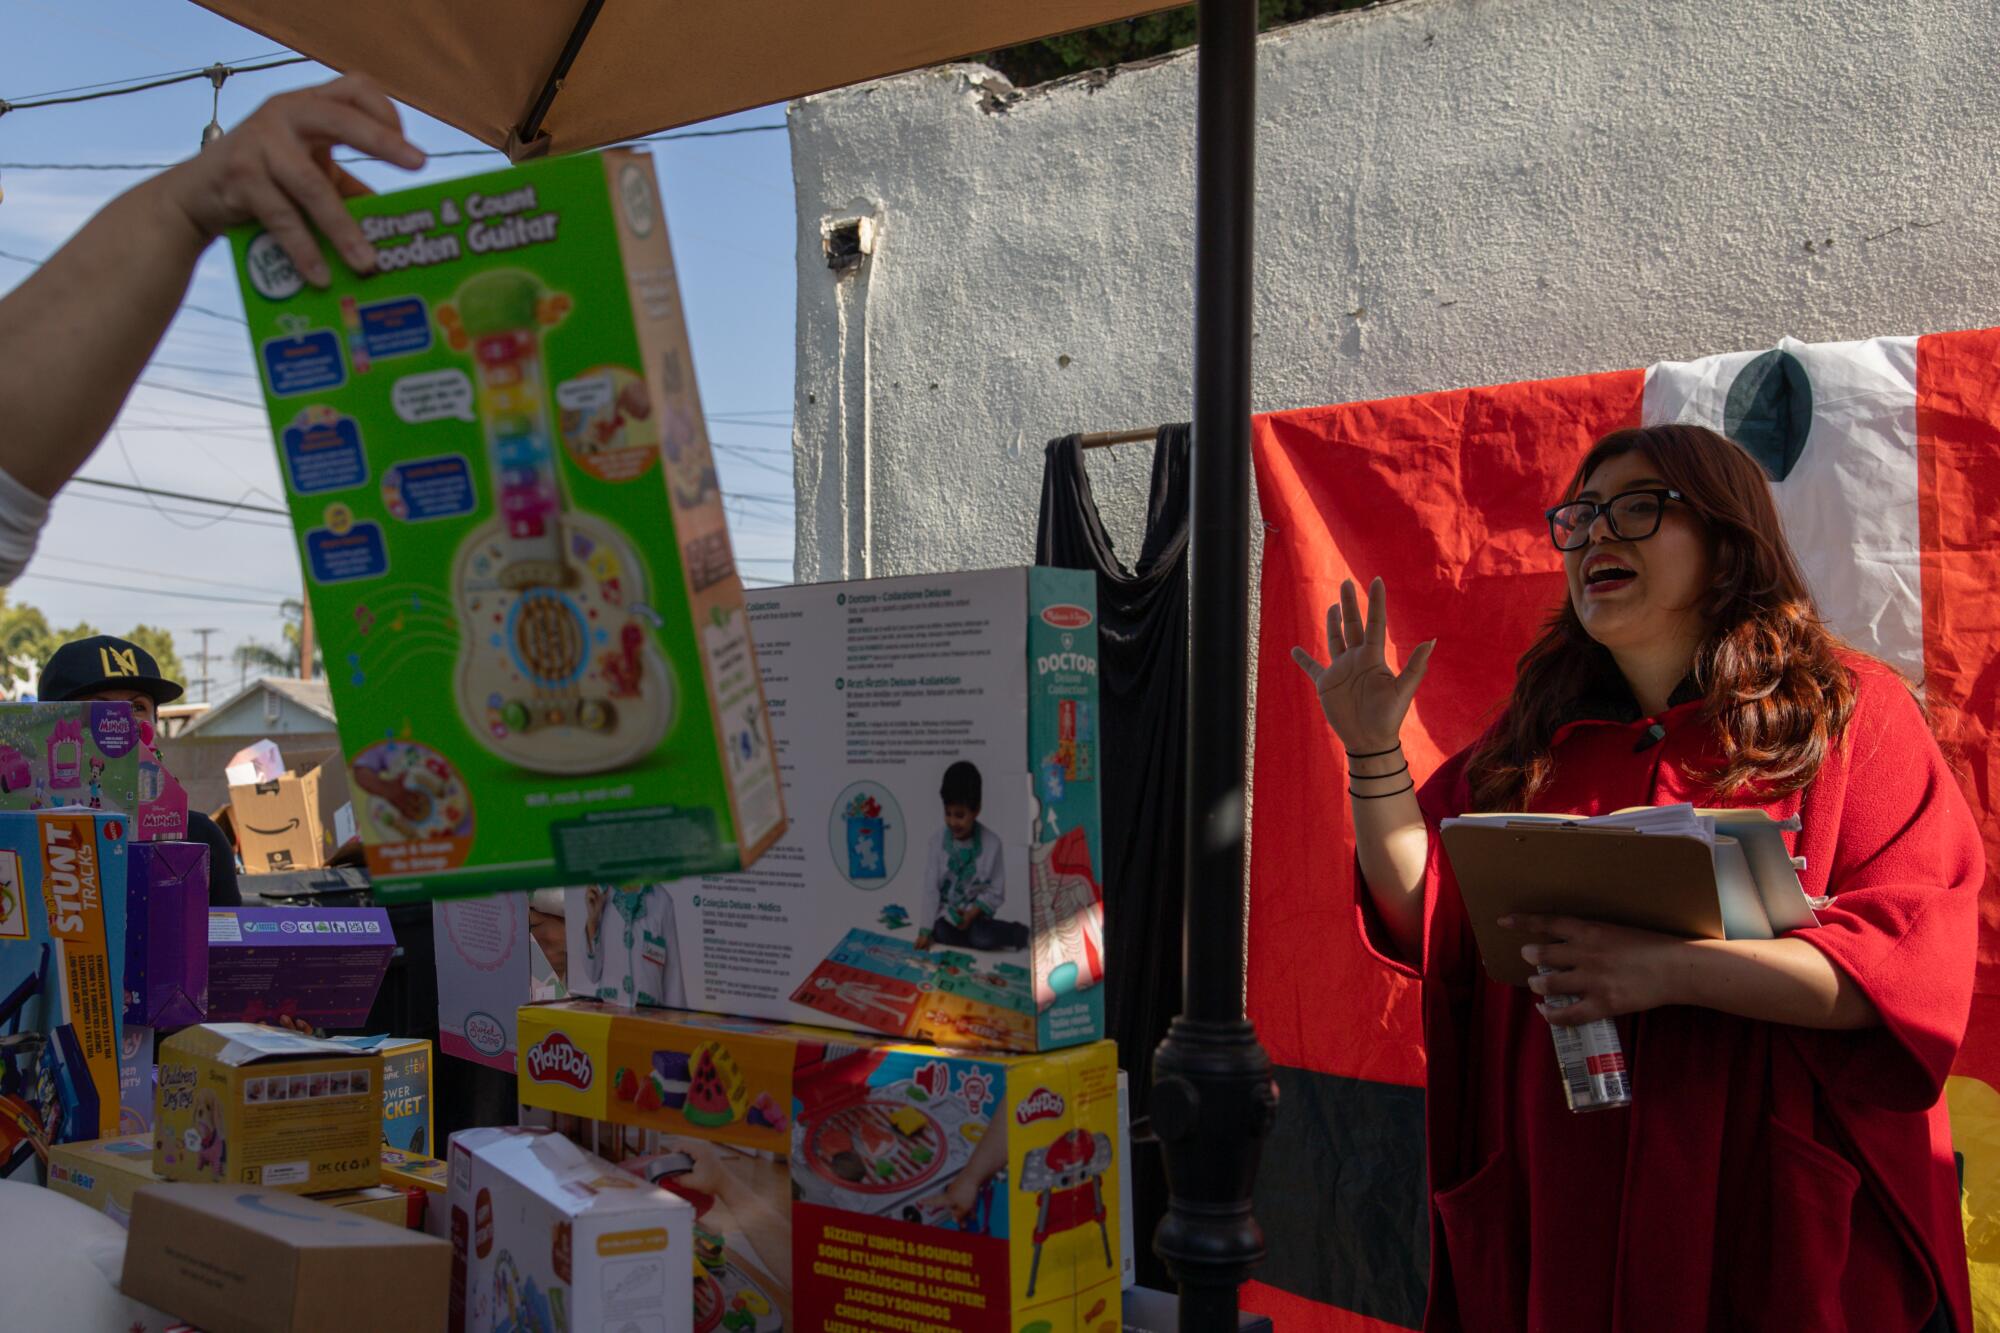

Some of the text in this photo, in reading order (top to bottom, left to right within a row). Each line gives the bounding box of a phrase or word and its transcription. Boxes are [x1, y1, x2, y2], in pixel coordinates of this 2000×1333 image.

[360, 184, 539, 243] Strum & Count
[374, 212, 559, 272] ooden Guitar
[1037, 652, 1097, 676] DOCTOR
[1047, 684, 1089, 696] Collection
[99, 717, 131, 734] MINNIE
[143, 811, 182, 828] MINNIE
[44, 822, 85, 934] STUNT
[77, 844, 98, 911] TRACKS
[405, 1063, 425, 1076] STEM
[528, 1043, 591, 1085] Play-Doh
[1017, 1092, 1063, 1122] Play-Doh
[817, 1243, 849, 1262] SONS
[850, 1250, 865, 1264] ET
[865, 1252, 925, 1277] LUMIÈRES
[926, 1264, 944, 1280] DE
[907, 1241, 916, 1256] &
[917, 1243, 974, 1267] SOUNDS!
[918, 1282, 927, 1298] &
[885, 1295, 896, 1310] Y
[895, 1298, 952, 1322] SONIDOS
